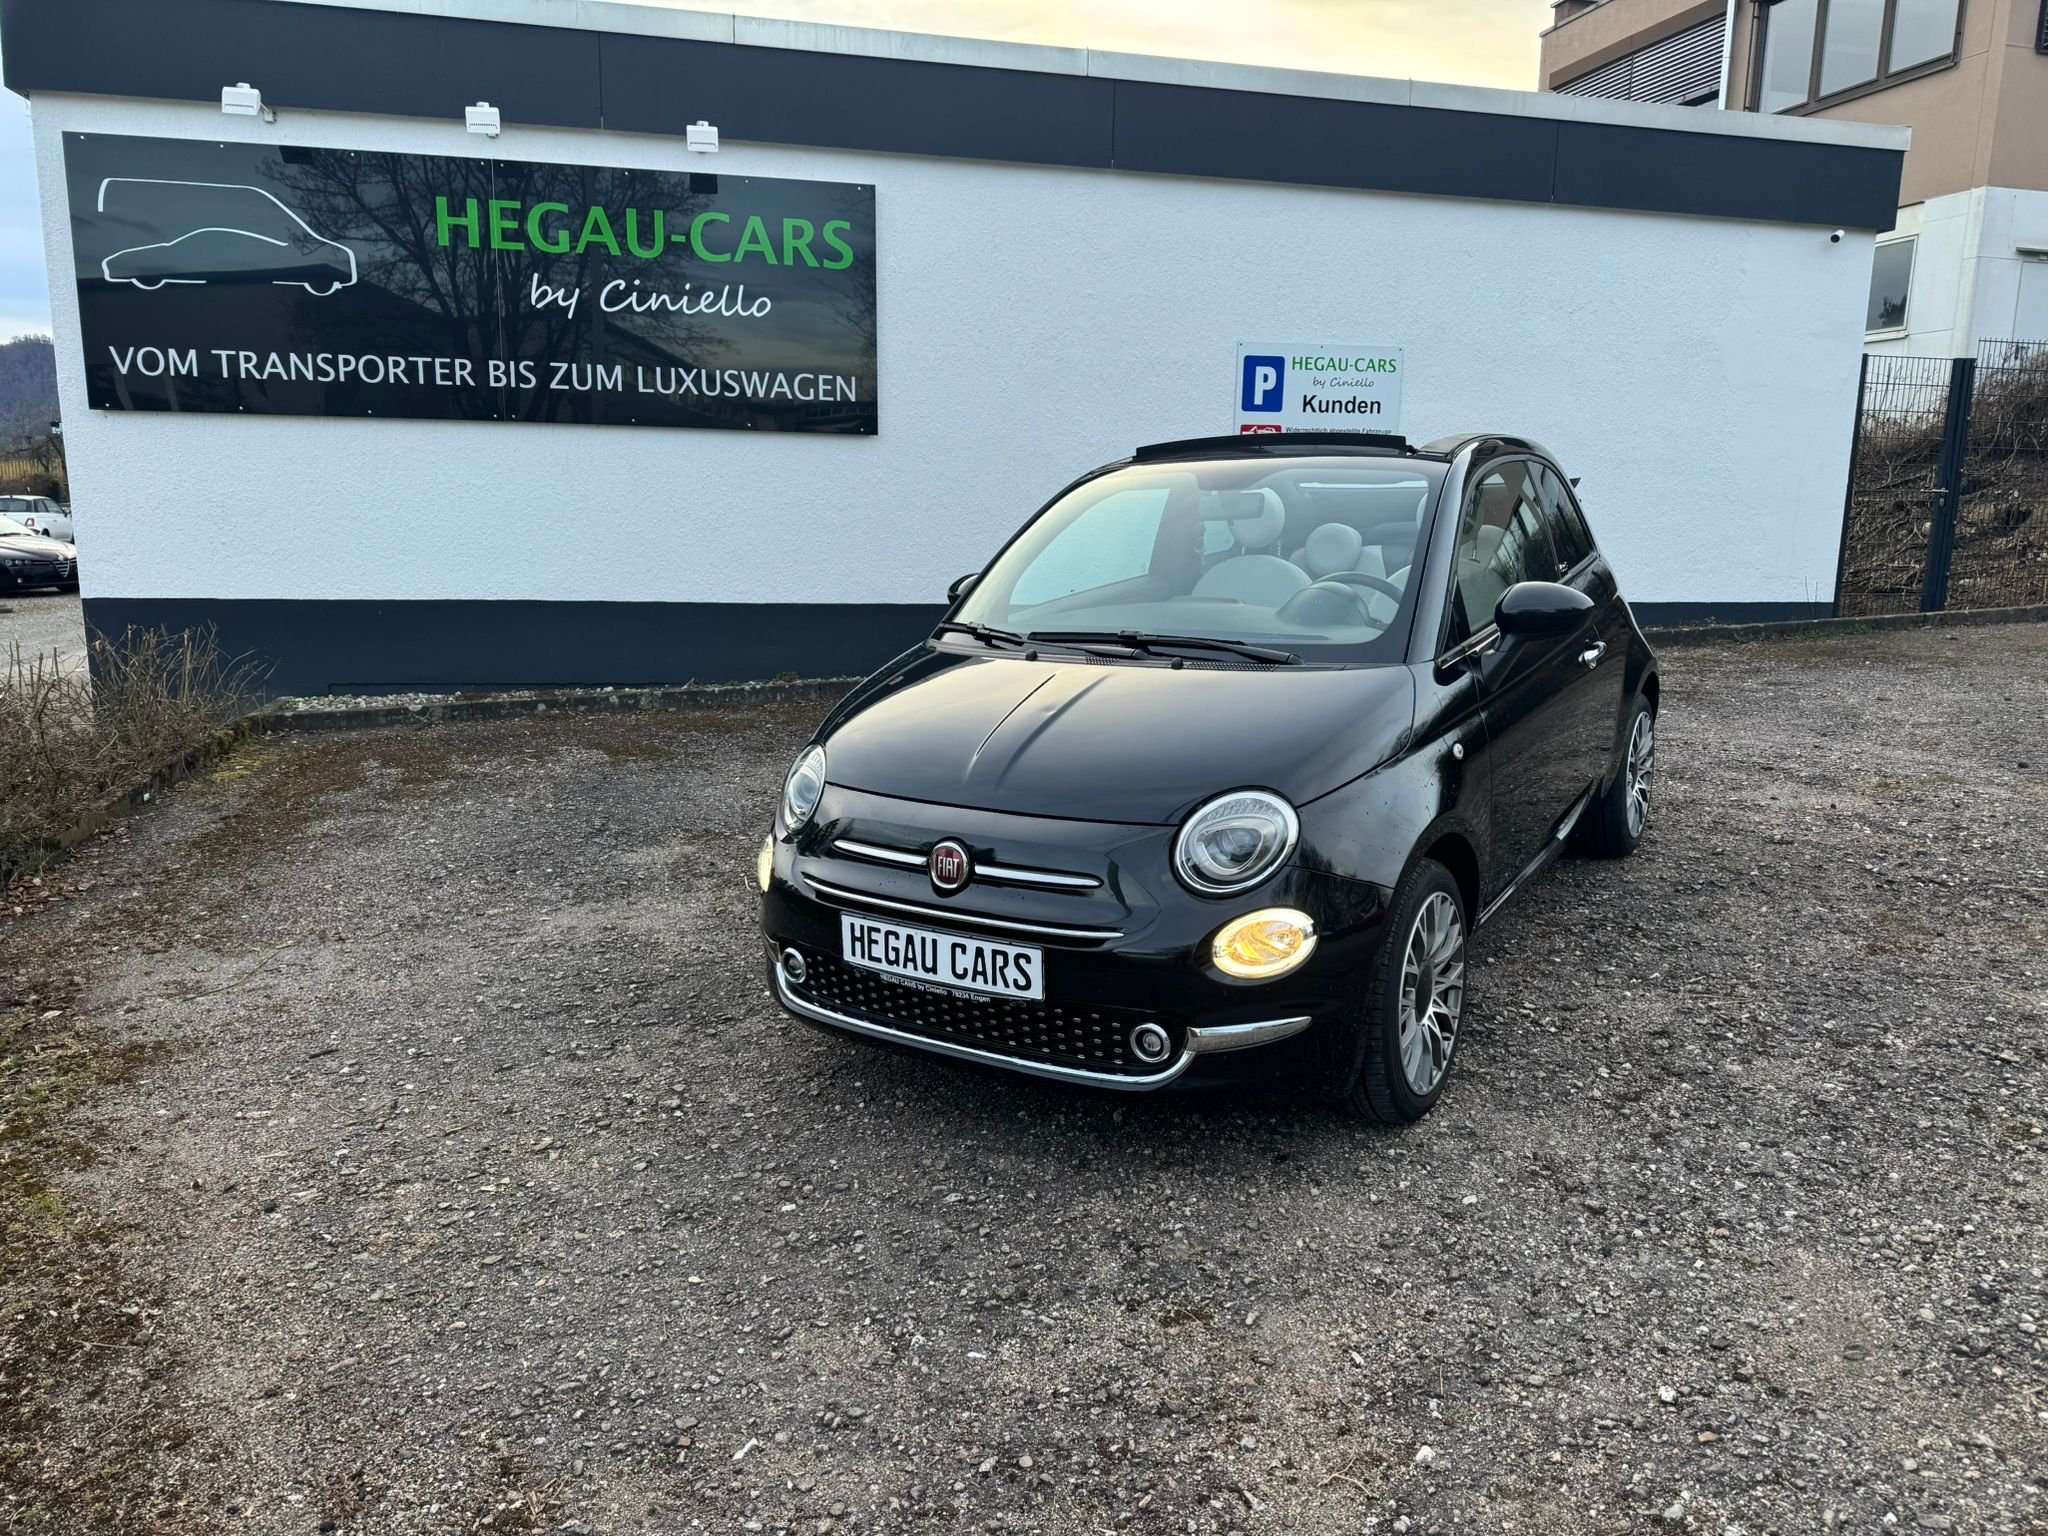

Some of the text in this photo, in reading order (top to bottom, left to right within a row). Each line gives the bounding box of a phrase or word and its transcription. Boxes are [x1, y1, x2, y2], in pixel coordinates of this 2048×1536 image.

[435, 196, 855, 270] HEGAU-CARS
[531, 272, 772, 319] by Ciniello
[109, 345, 857, 402] VOM TRANSPORTER BIS ZUM LUXUSWAGEN
[1291, 356, 1397, 373] HEGAU-CARS
[1312, 376, 1375, 388] by Ciniello
[1253, 366, 1277, 405] P
[1302, 394, 1381, 415] Kunden
[937, 855, 960, 879] FIAT
[849, 922, 1032, 991] HEGAU CARS
